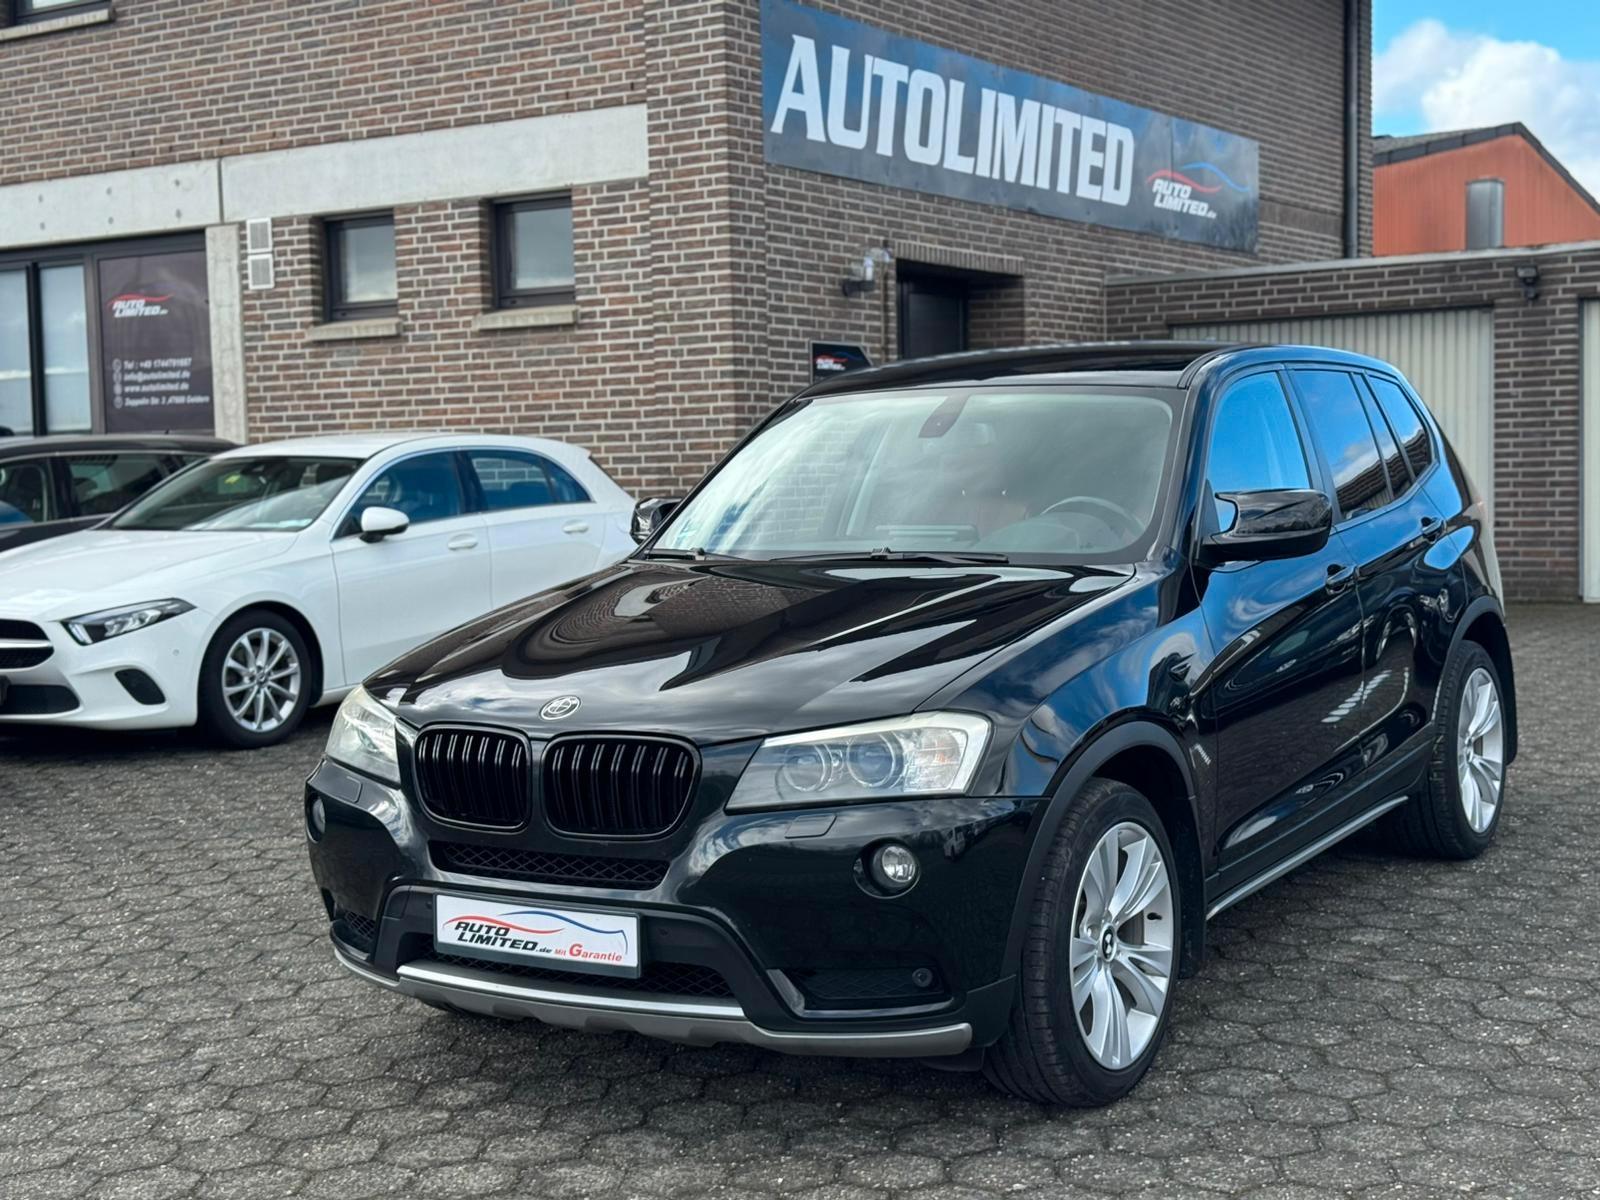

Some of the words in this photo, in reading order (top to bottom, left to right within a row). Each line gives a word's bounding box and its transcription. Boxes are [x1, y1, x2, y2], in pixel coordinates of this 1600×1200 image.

[771, 34, 1134, 206] AUTOLIMITED
[1152, 179, 1192, 199] AUTO
[1153, 193, 1217, 219] LIMITED.de
[112, 299, 145, 310] AUTO
[123, 360, 134, 370] Tel
[455, 921, 510, 936] AUTO
[458, 933, 553, 953] LIMITED.de
[569, 943, 622, 963] Garantie
